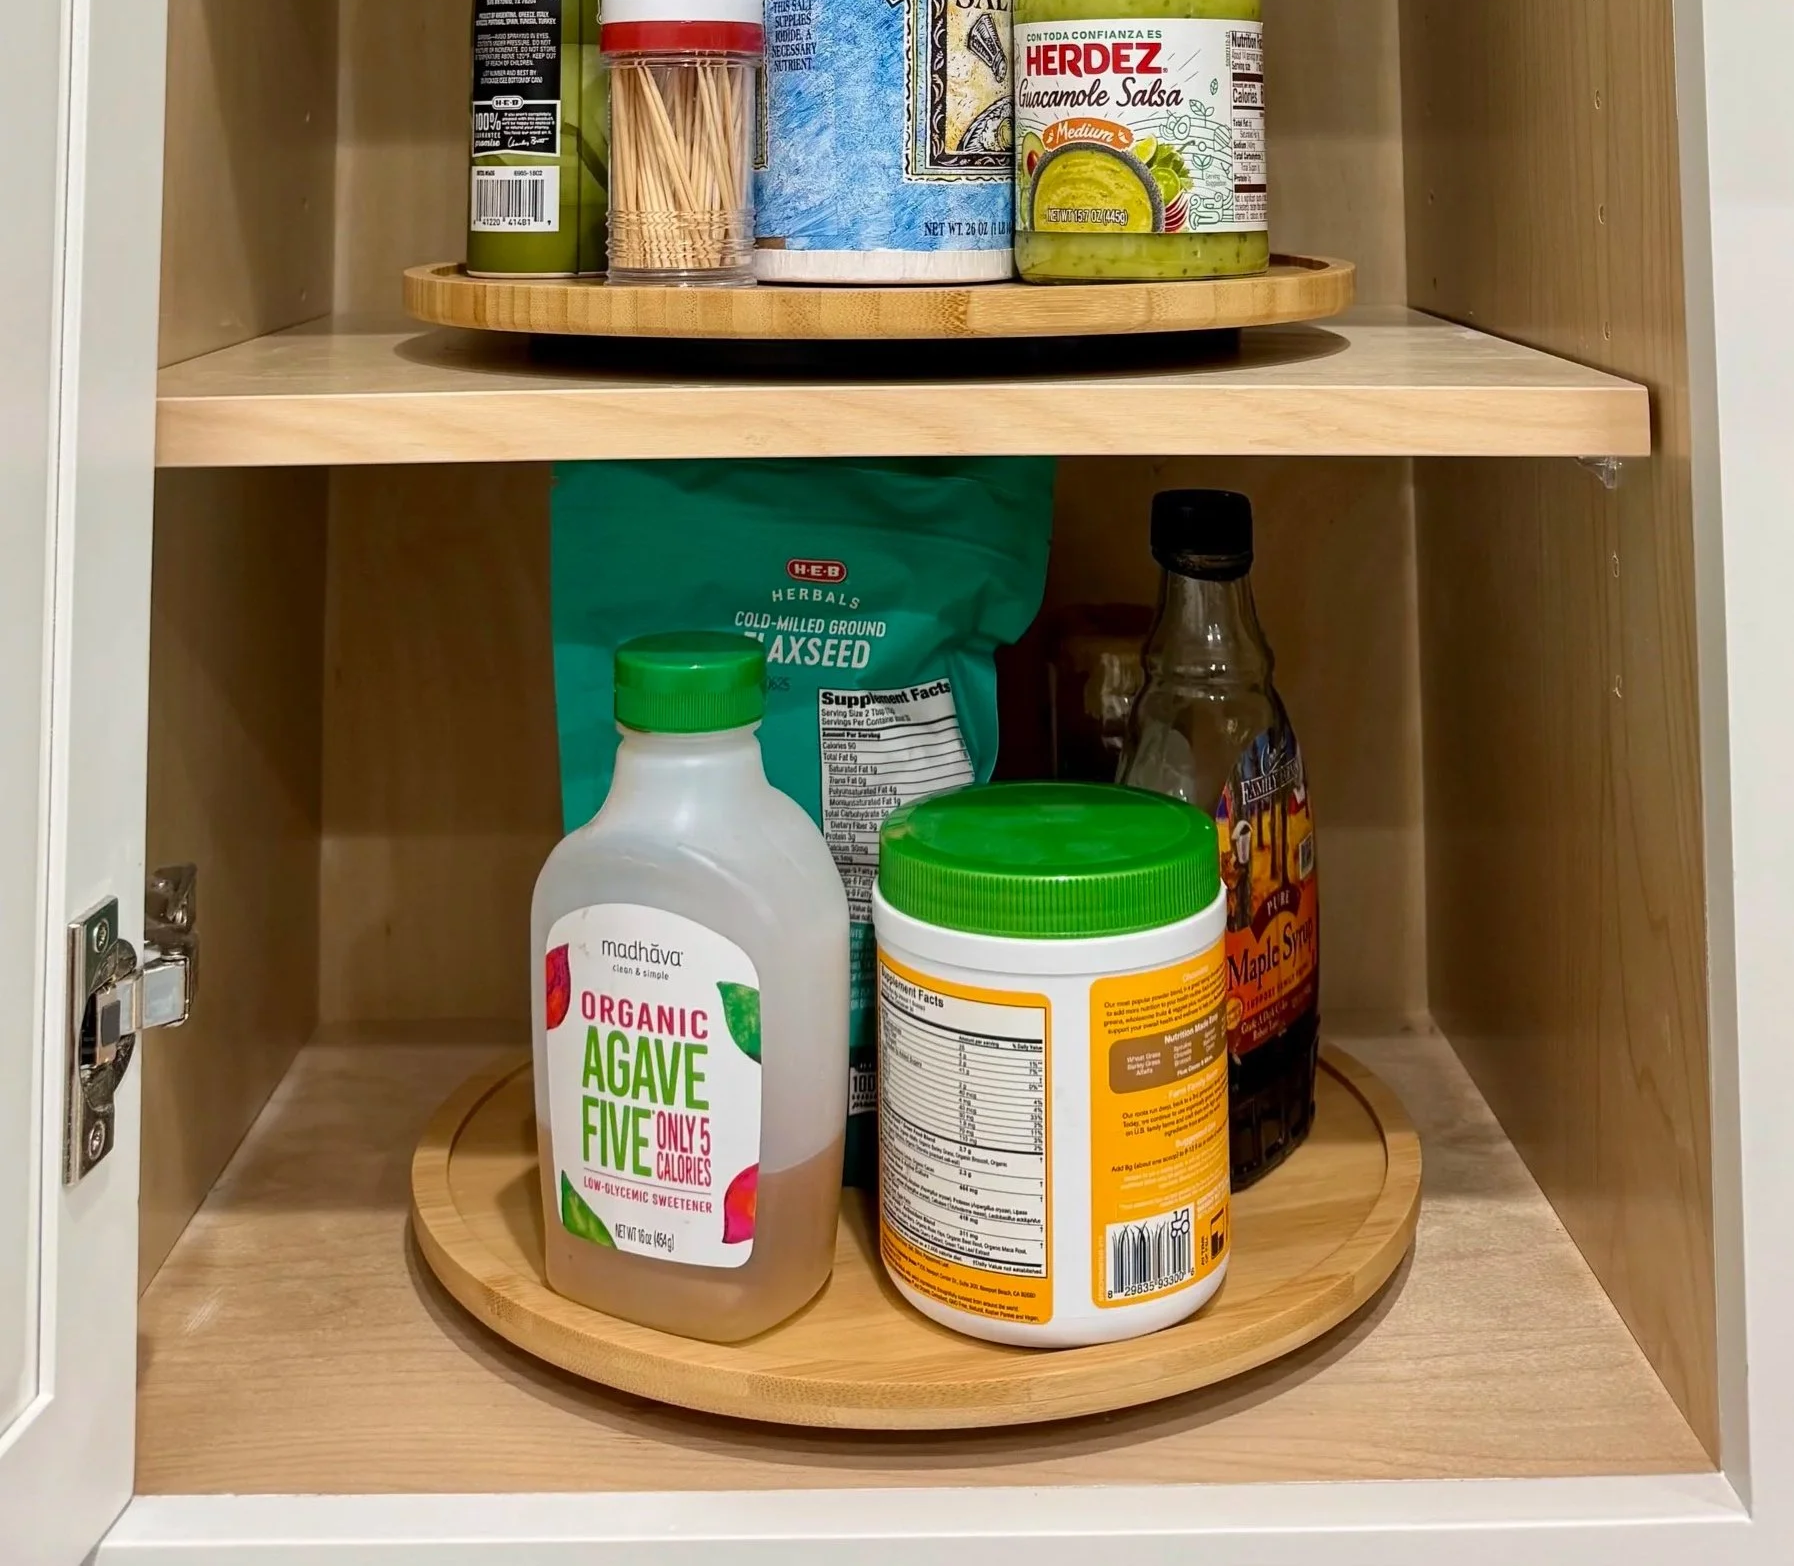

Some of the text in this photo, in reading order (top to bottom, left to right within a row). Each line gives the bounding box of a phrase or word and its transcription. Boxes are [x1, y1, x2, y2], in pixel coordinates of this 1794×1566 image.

[773, 0, 790, 14] THIS
[774, 12, 812, 28] SUPPLIES
[774, 28, 812, 44] IODIDE, A
[1026, 29, 1162, 43] CON TODA CONFIANZA ES
[1231, 32, 1257, 49] Nutrition
[771, 41, 817, 59] NECESSARY
[1026, 42, 1163, 78] HERDEZ
[1018, 76, 1184, 109] Guacamole Salsa
[1232, 88, 1257, 105] Calories
[475, 112, 501, 131] 100%
[1057, 121, 1115, 144] Medium
[1048, 208, 1062, 223] NET
[1092, 208, 1104, 223] OZ
[1105, 208, 1129, 226] (445g)
[924, 221, 946, 237] NET
[948, 222, 964, 237] WT.
[966, 222, 977, 236] 26
[978, 222, 989, 236] OZ
[772, 587, 860, 610] HERBALS
[735, 611, 887, 638] COLD-MILLED GROUND
[821, 680, 952, 709] Supplement Facts
[822, 708, 862, 719] Serving Size
[822, 717, 865, 728] Servings Per
[858, 731, 881, 740] Serving
[823, 742, 847, 751] Calories
[823, 753, 849, 762] Total Fat
[829, 765, 869, 774] Saturated Fat
[847, 776, 857, 784] Fat
[1241, 772, 1278, 805] FAMILY
[825, 808, 880, 821] Total Carbohydrate
[830, 821, 867, 832] Dietary Fiber
[825, 833, 846, 842] Protein
[1266, 889, 1291, 916] PURE
[1227, 918, 1313, 991] Maple Syrup
[612, 964, 669, 981] clean simple
[918, 989, 944, 1009] Facts
[1131, 996, 1151, 1006] popular
[581, 990, 708, 1040] ORGANIC
[1164, 1028, 1194, 1045] Nutrition
[1194, 1020, 1209, 1035] Made
[582, 1024, 710, 1111] AGAVE
[1127, 1061, 1146, 1071] Barley
[582, 1094, 652, 1177] FIVE
[656, 1110, 711, 1157] ONLY 5
[656, 1150, 712, 1197] CALORIES
[583, 1175, 712, 1214] LOW-GLYCEMIC SWEETENER
[615, 1223, 626, 1239] NET
[627, 1224, 637, 1240] WT
[638, 1227, 645, 1243] 16
[645, 1230, 653, 1244] oz
[1107, 1270, 1185, 1299] 8 29835 93300
